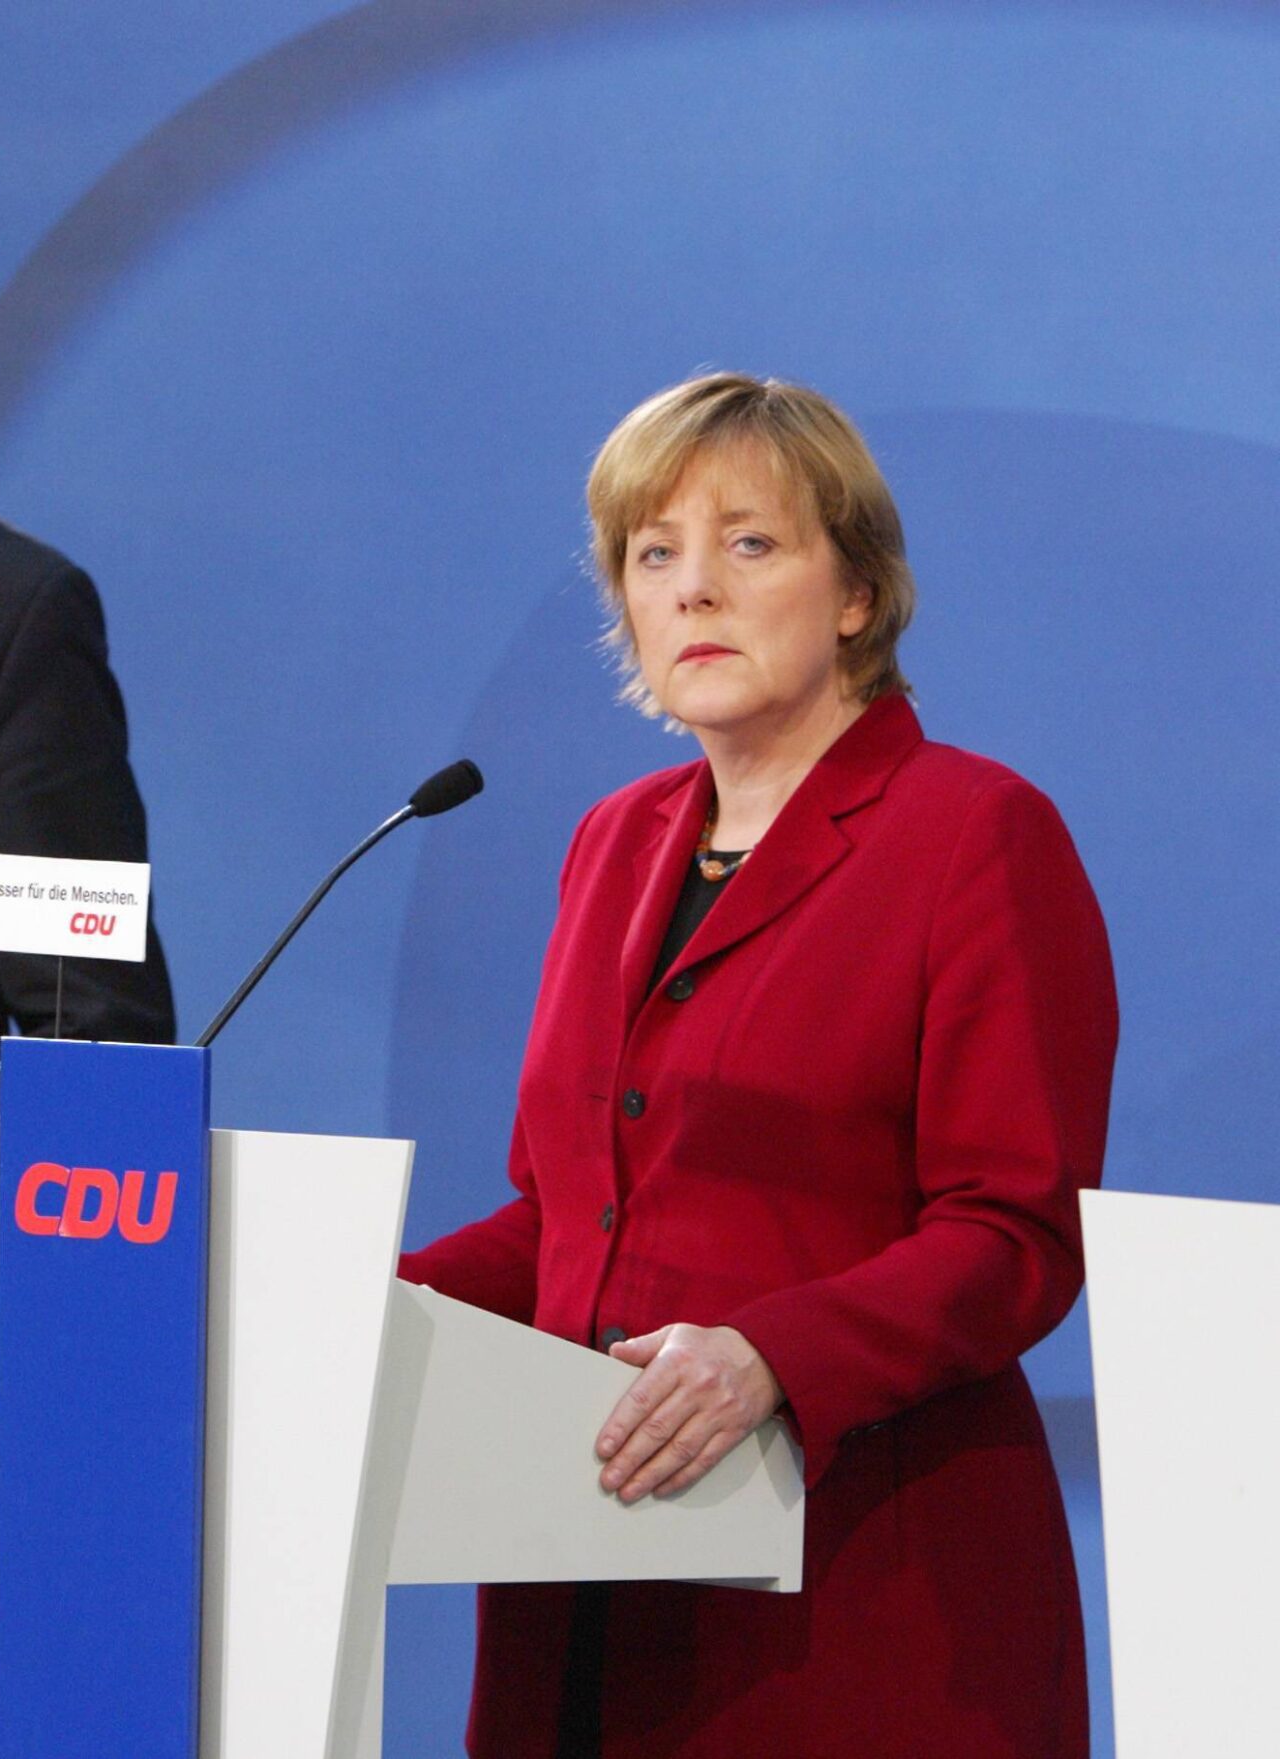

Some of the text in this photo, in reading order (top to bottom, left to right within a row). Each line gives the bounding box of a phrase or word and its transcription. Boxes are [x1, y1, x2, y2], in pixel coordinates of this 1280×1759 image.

[28, 882, 45, 899] für
[49, 885, 67, 901] die
[71, 886, 139, 906] Menschen.
[70, 912, 117, 936] CDU
[14, 1161, 179, 1245] CDU
